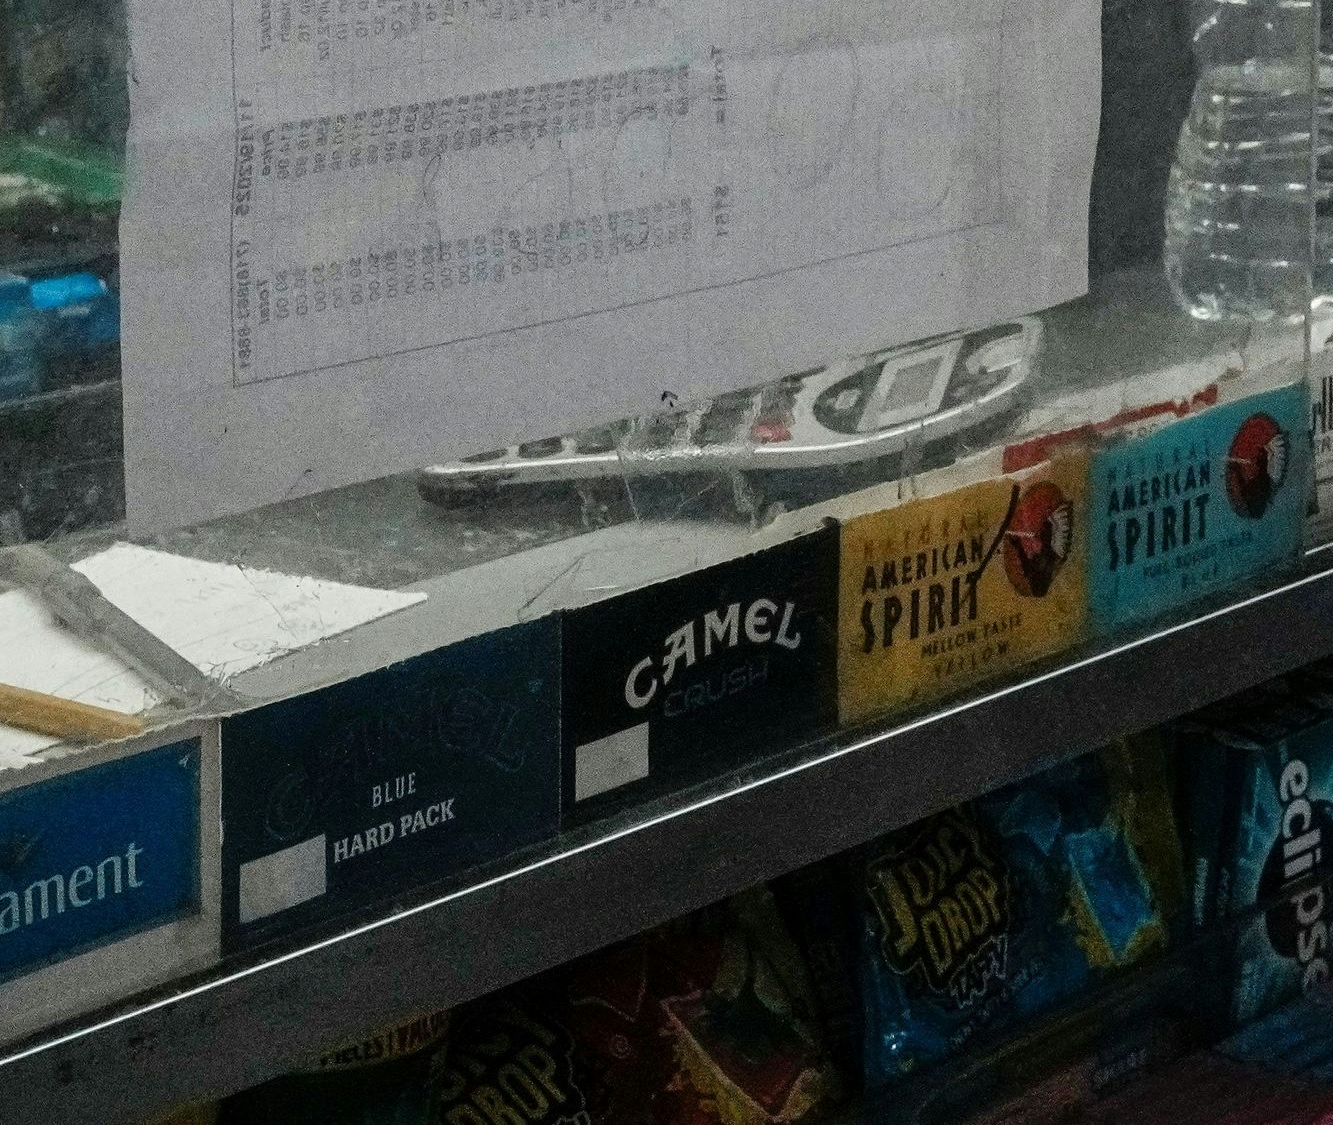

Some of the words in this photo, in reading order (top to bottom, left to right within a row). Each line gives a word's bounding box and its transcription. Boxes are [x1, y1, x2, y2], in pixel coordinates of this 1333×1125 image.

[1106, 459, 1211, 517] AMERICAN
[860, 533, 986, 595] AMERICAN
[1106, 492, 1210, 572] SPIRIT
[860, 568, 980, 654] SPIRIT
[920, 628, 978, 657] MELLOW
[623, 596, 803, 710] CAMEL
[371, 771, 417, 809] BLUE
[333, 820, 396, 864] HARD
[400, 798, 457, 839] PACK
[0, 840, 144, 937] ament
[919, 866, 1002, 977] DROP
